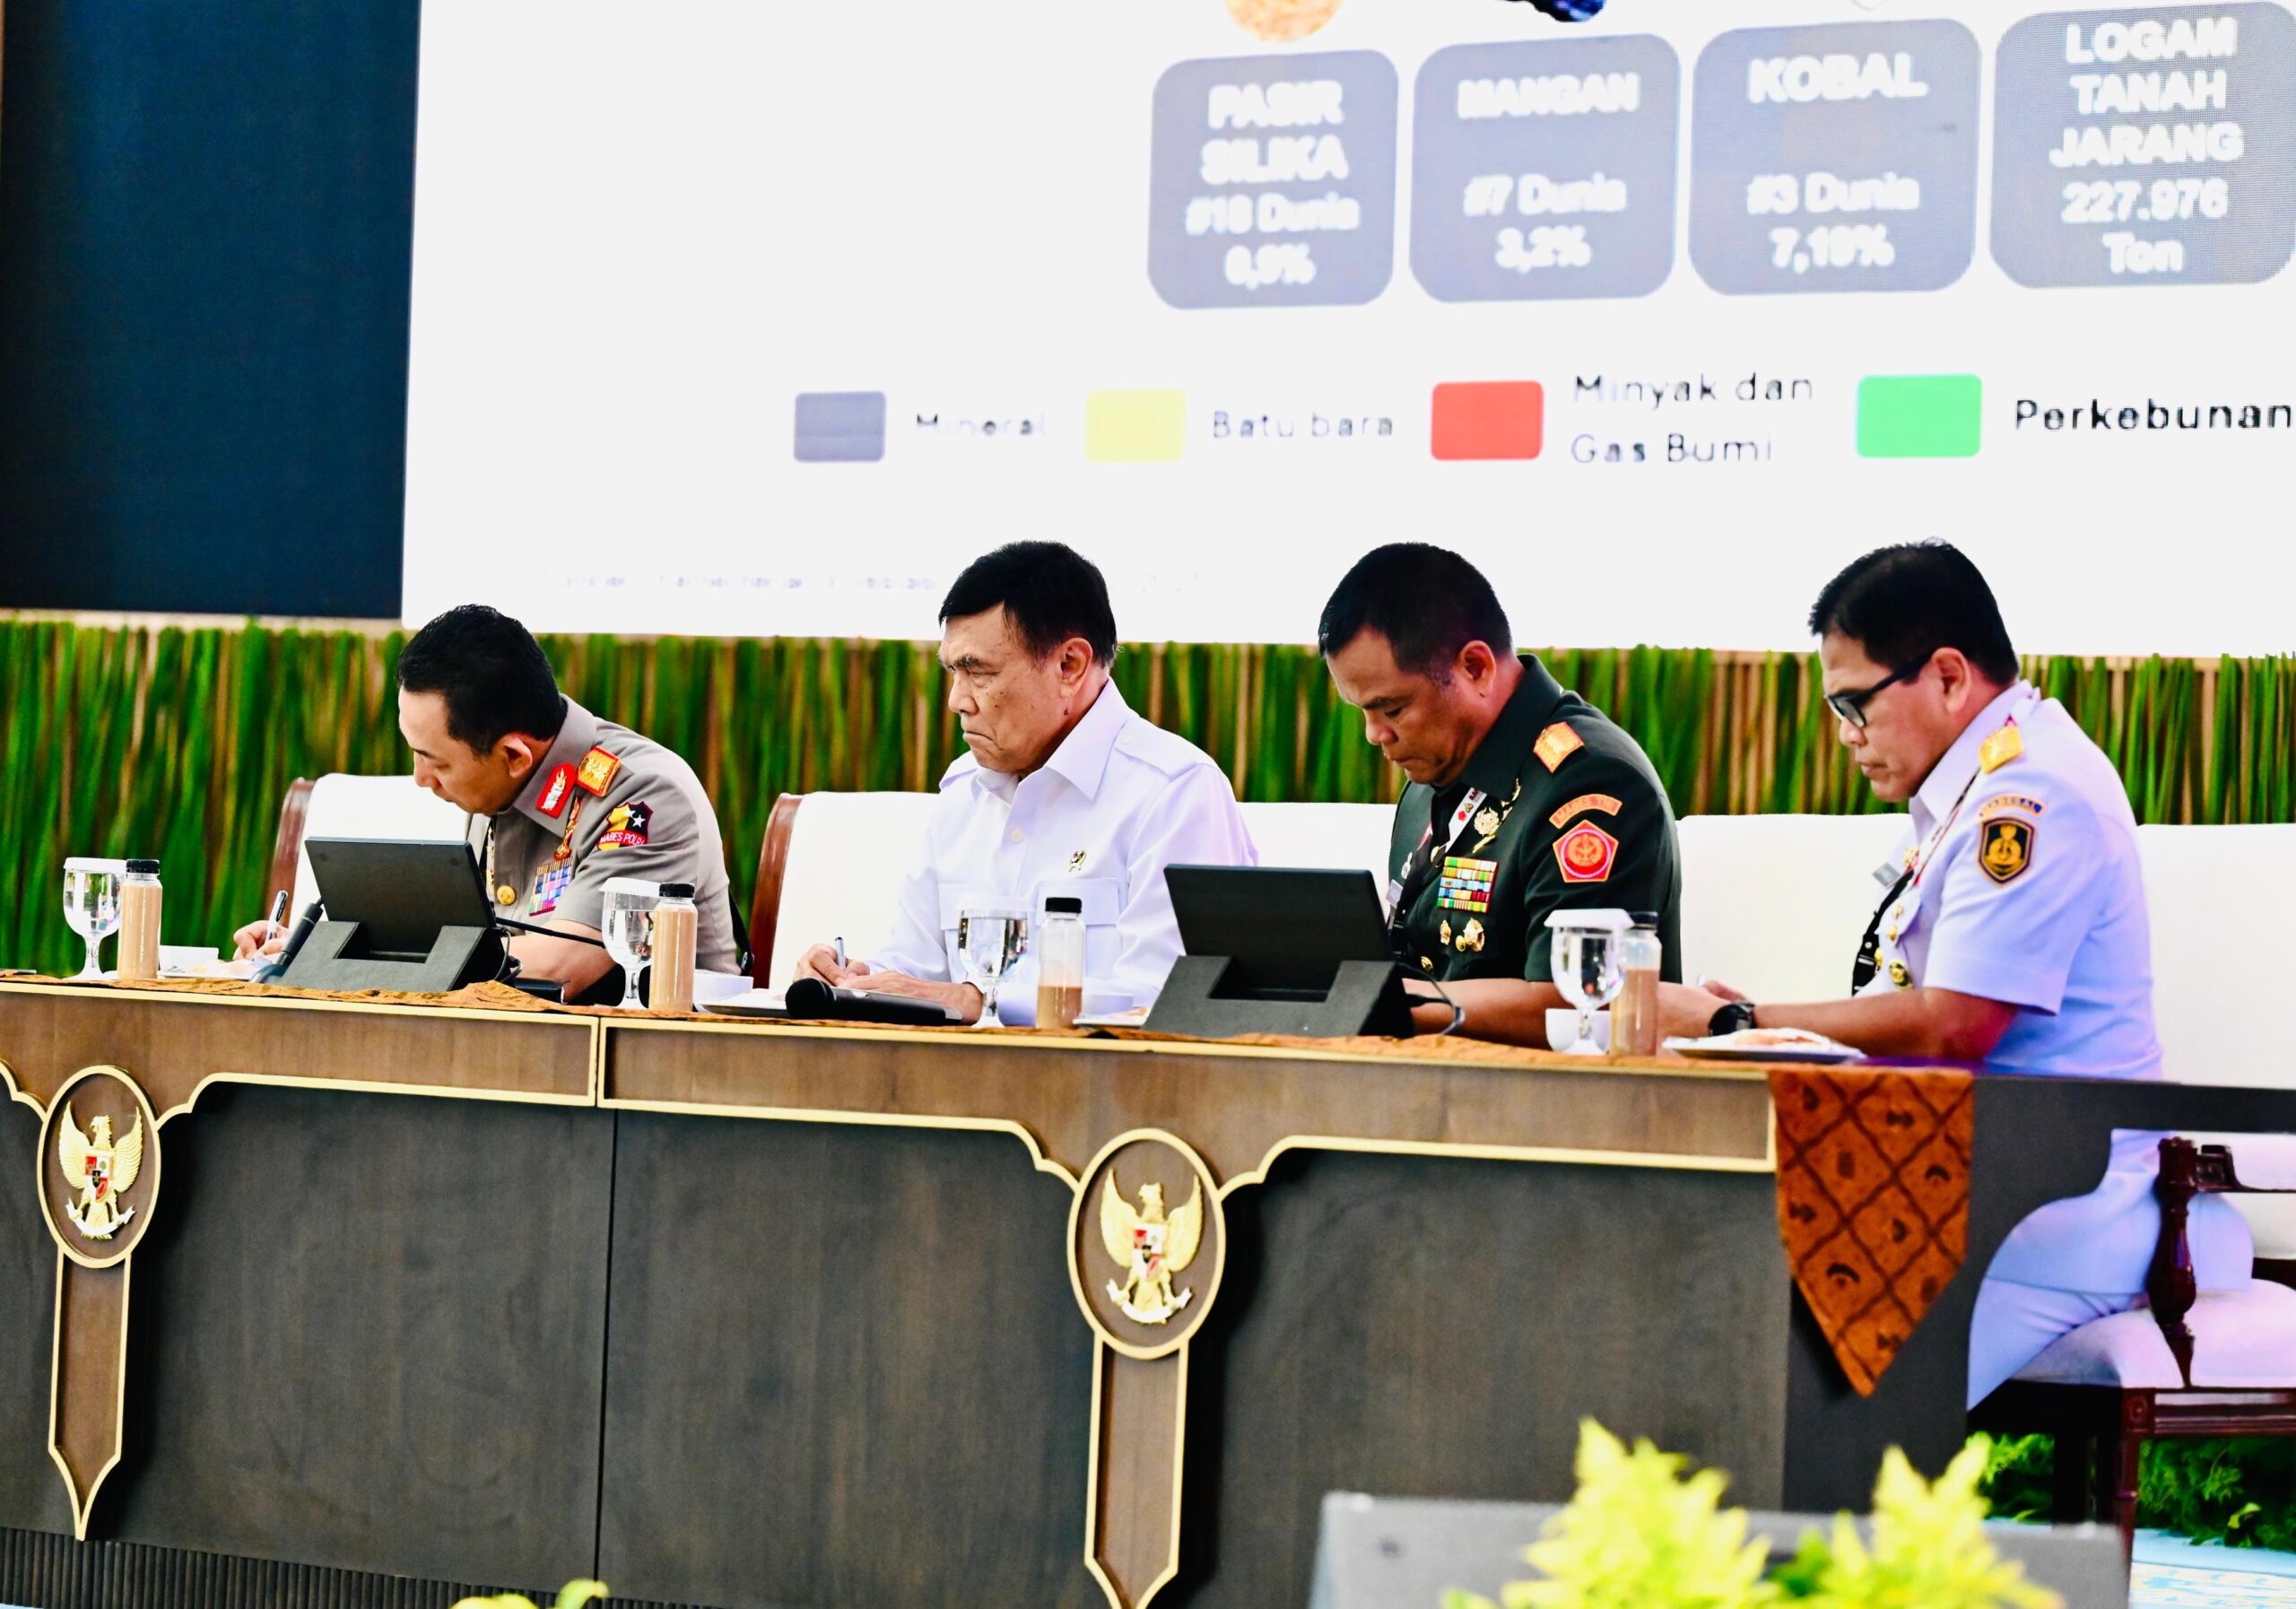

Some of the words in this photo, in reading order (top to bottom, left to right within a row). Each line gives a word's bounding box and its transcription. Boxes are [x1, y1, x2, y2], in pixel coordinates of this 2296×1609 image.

[2066, 17, 2237, 63] LOGAM
[1750, 53, 1927, 102] KOBAL
[2071, 71, 2226, 113] TANAH
[2050, 123, 2243, 167] JARANG
[1518, 173, 1626, 214] Dunia
[1806, 173, 1919, 212] Dunia
[2063, 178, 2227, 222] 227.976
[2103, 233, 2182, 273] Ton
[1735, 370, 1813, 403] dan
[916, 411, 1046, 437] Mneral
[1213, 410, 1294, 439] Batu
[1310, 411, 1394, 439] bara
[2014, 397, 2293, 432] Perkebunan
[1570, 432, 1647, 465] Gas
[1666, 431, 1772, 465] Bumi
[599, 831, 623, 844] MABES
